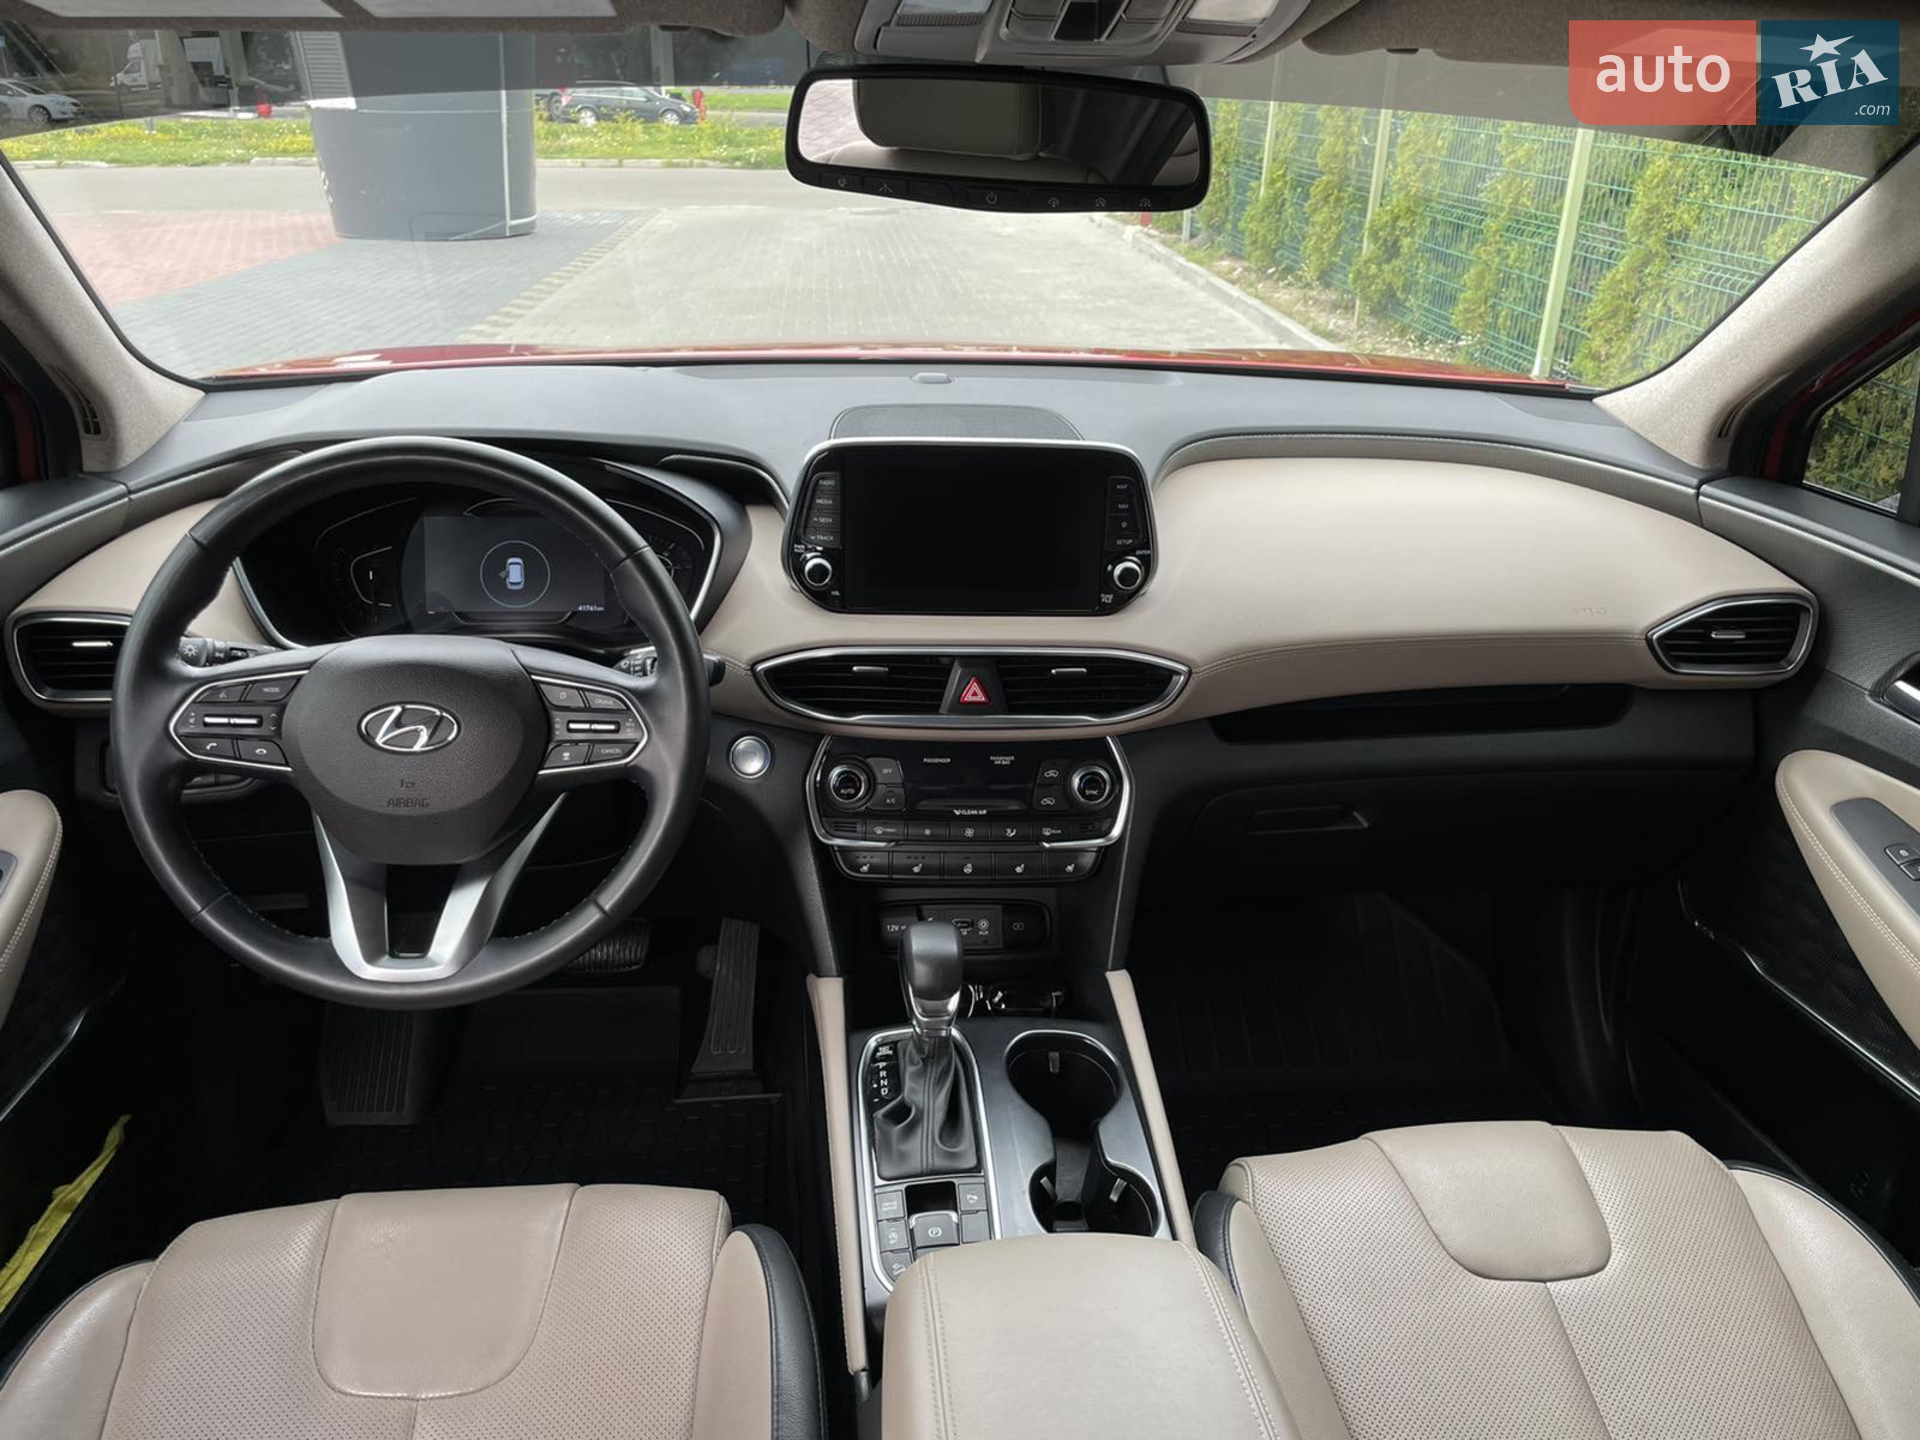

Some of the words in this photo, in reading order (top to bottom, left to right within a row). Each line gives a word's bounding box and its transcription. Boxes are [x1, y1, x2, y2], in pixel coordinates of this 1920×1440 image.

[387, 797, 430, 808] AIRBAG
[880, 1070, 887, 1078] R
[881, 1088, 889, 1096] D
